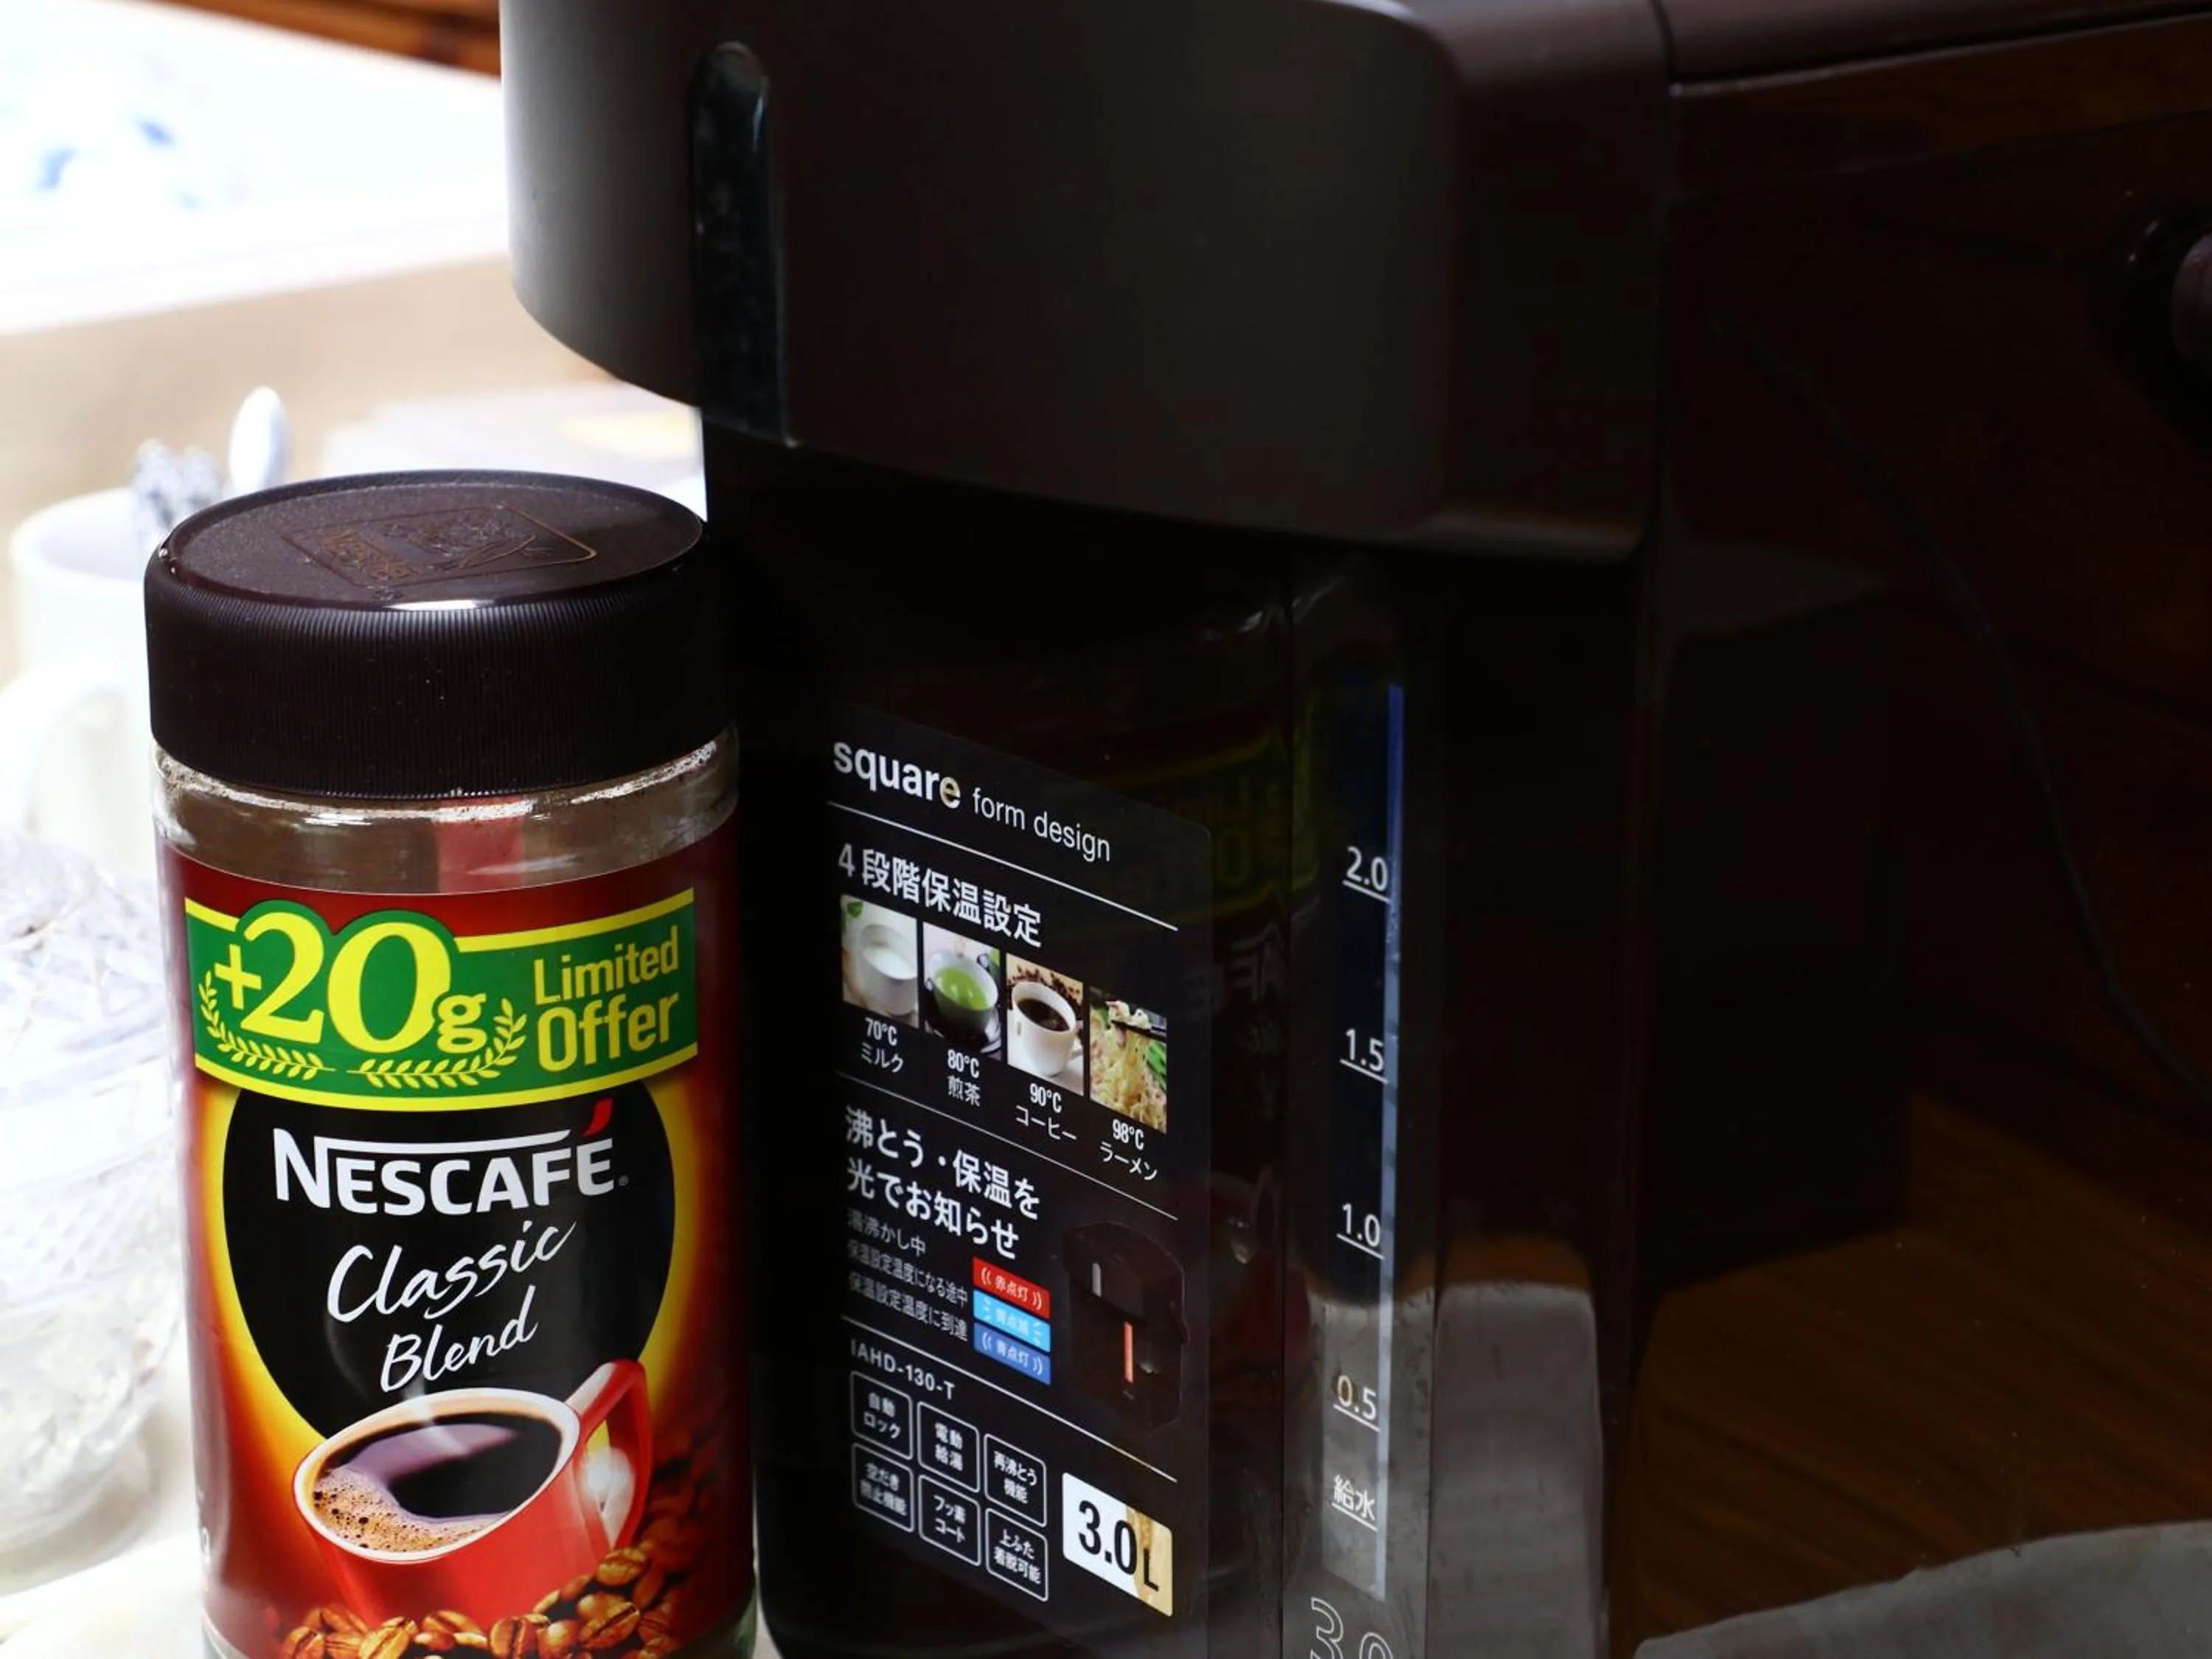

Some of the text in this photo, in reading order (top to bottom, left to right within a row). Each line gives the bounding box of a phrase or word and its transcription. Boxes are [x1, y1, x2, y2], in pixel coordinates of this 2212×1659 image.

[832, 741, 1110, 863] square form design
[1346, 844, 1389, 892] 2.0
[838, 843, 1042, 948] 4段階保温設定
[214, 911, 487, 1054] +20g
[534, 925, 679, 1007] Limited
[537, 990, 680, 1074] Offer
[1344, 1027, 1384, 1073] 1.5
[860, 1042, 905, 1074] ミルク
[947, 1076, 981, 1107] 煎茶
[1015, 1105, 1077, 1143] コーヒー
[273, 1098, 615, 1217] NESCAFÉ
[1099, 1141, 1158, 1181] ラーメン
[846, 1158, 1020, 1260] 光でお知らせ
[1341, 1203, 1381, 1248] 1.0
[326, 1220, 577, 1323] Classic
[379, 1285, 538, 1393] Blend
[850, 1338, 956, 1400] IAHD-130-T
[1336, 1374, 1377, 1421] 0.5
[863, 1411, 902, 1439] ロック
[1333, 1474, 1376, 1522] 給水
[934, 1517, 966, 1543] コート
